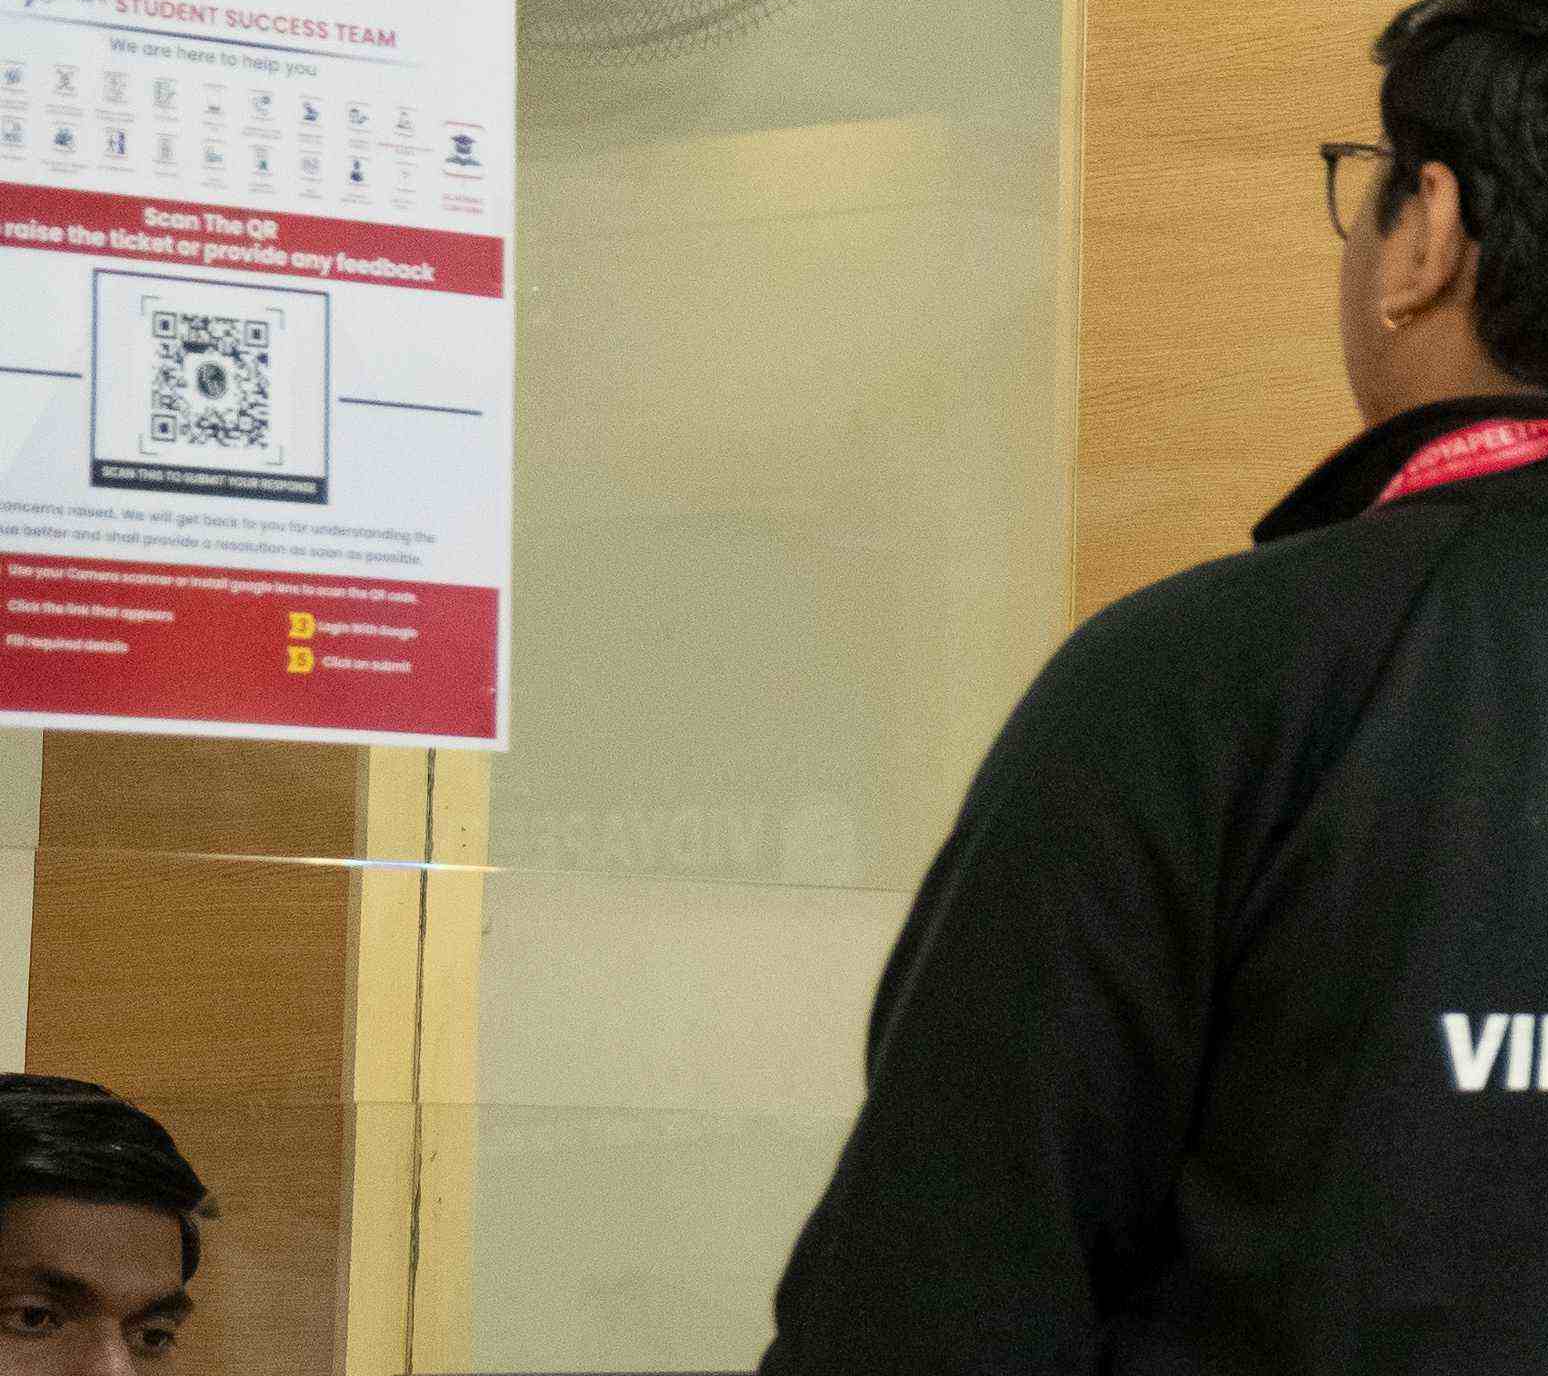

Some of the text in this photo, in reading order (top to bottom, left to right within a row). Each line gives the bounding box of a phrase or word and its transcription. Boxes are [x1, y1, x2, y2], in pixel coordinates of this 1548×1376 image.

[225, 8, 330, 40] SUCCESS
[336, 23, 398, 48] TEAM
[109, 35, 317, 78] We are here to help you
[143, 206, 278, 240] Scan The QR
[4, 219, 435, 282] raise the ticket or provide any feedback
